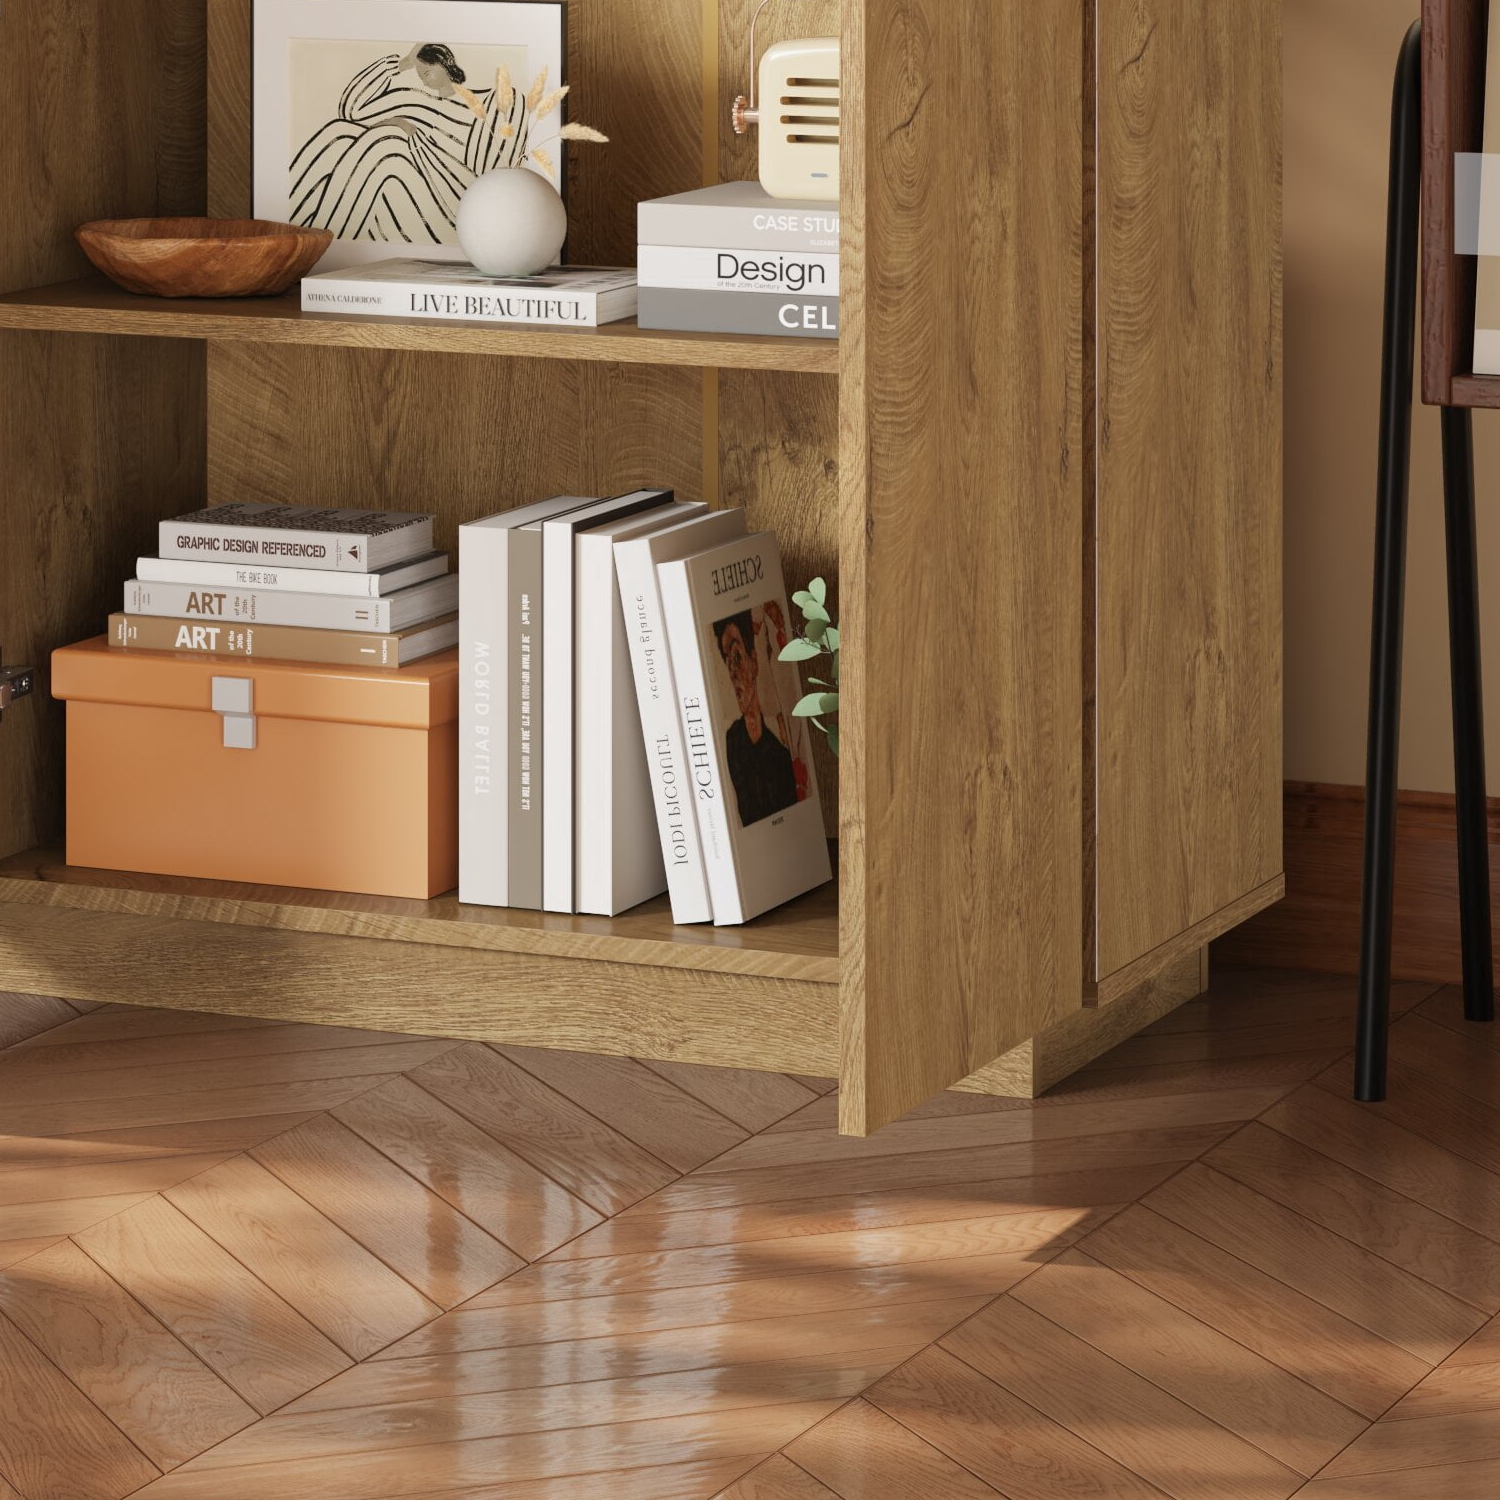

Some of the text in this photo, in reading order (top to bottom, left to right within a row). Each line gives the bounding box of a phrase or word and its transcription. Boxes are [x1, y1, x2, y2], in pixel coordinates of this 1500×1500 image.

[753, 214, 839, 233] CASE STU
[717, 253, 825, 292] Design
[307, 293, 336, 304] ATHENA
[754, 282, 781, 291] Century
[410, 293, 588, 322] LIVE BEAUTIFUL
[177, 535, 220, 554] GRAPHIC
[223, 537, 259, 554] DESIGN
[262, 540, 326, 559] REFERENCED
[236, 571, 278, 585] THE BIKE BOOK
[186, 591, 227, 616] ART
[175, 625, 220, 650] ART
[245, 628, 254, 655] Century
